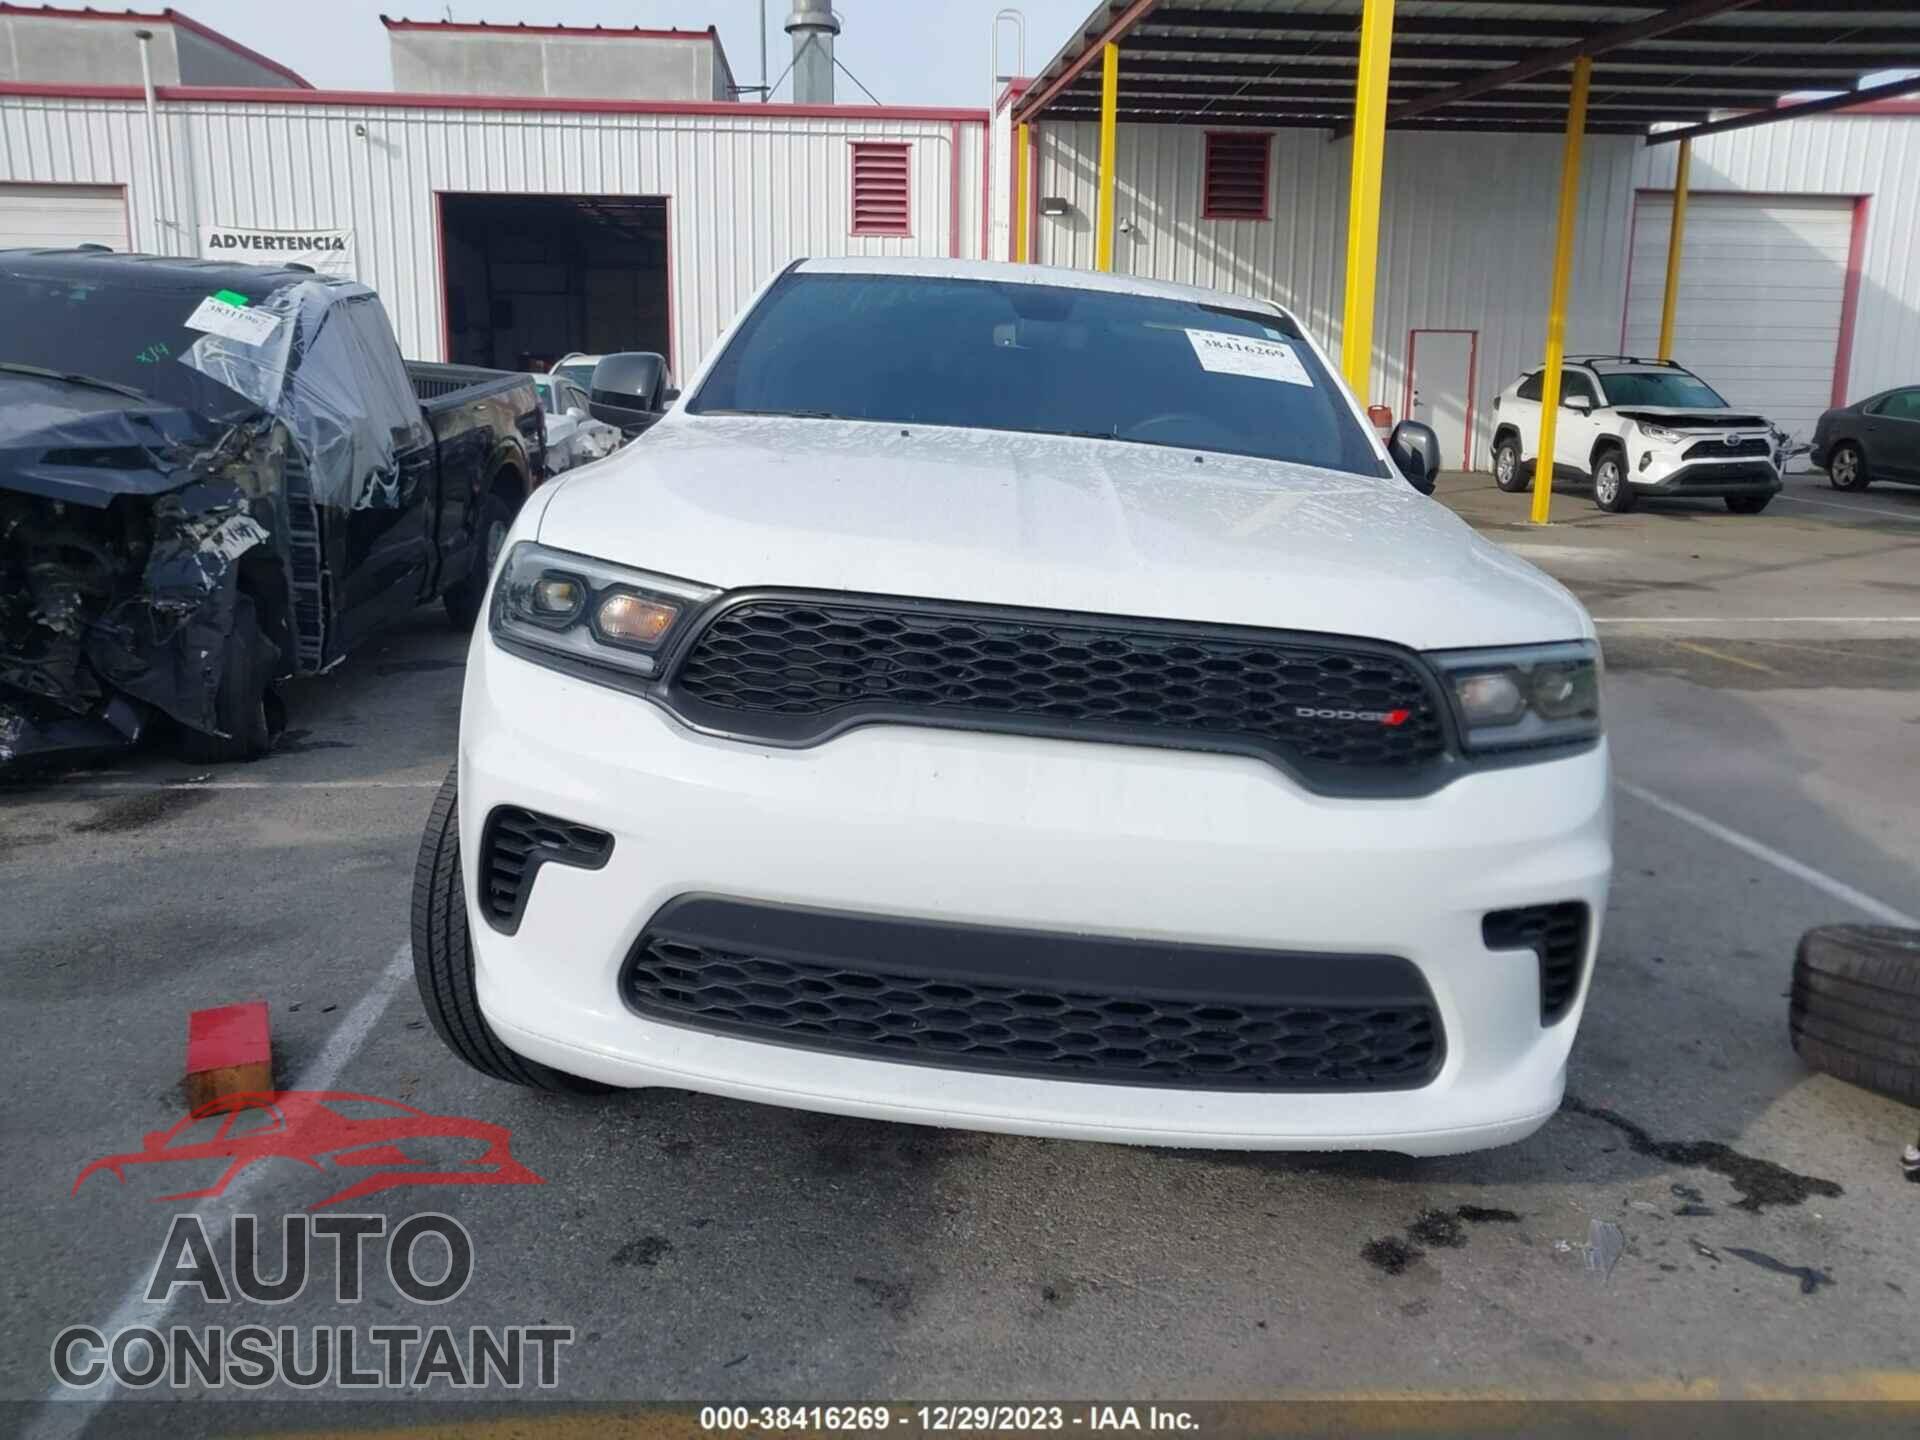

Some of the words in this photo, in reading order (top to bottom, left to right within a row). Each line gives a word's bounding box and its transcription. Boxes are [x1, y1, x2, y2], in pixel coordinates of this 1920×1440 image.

[209, 233, 346, 251] ADVERTENCIA
[1201, 338, 1287, 359] 38416269
[1295, 707, 1386, 721] DODGE
